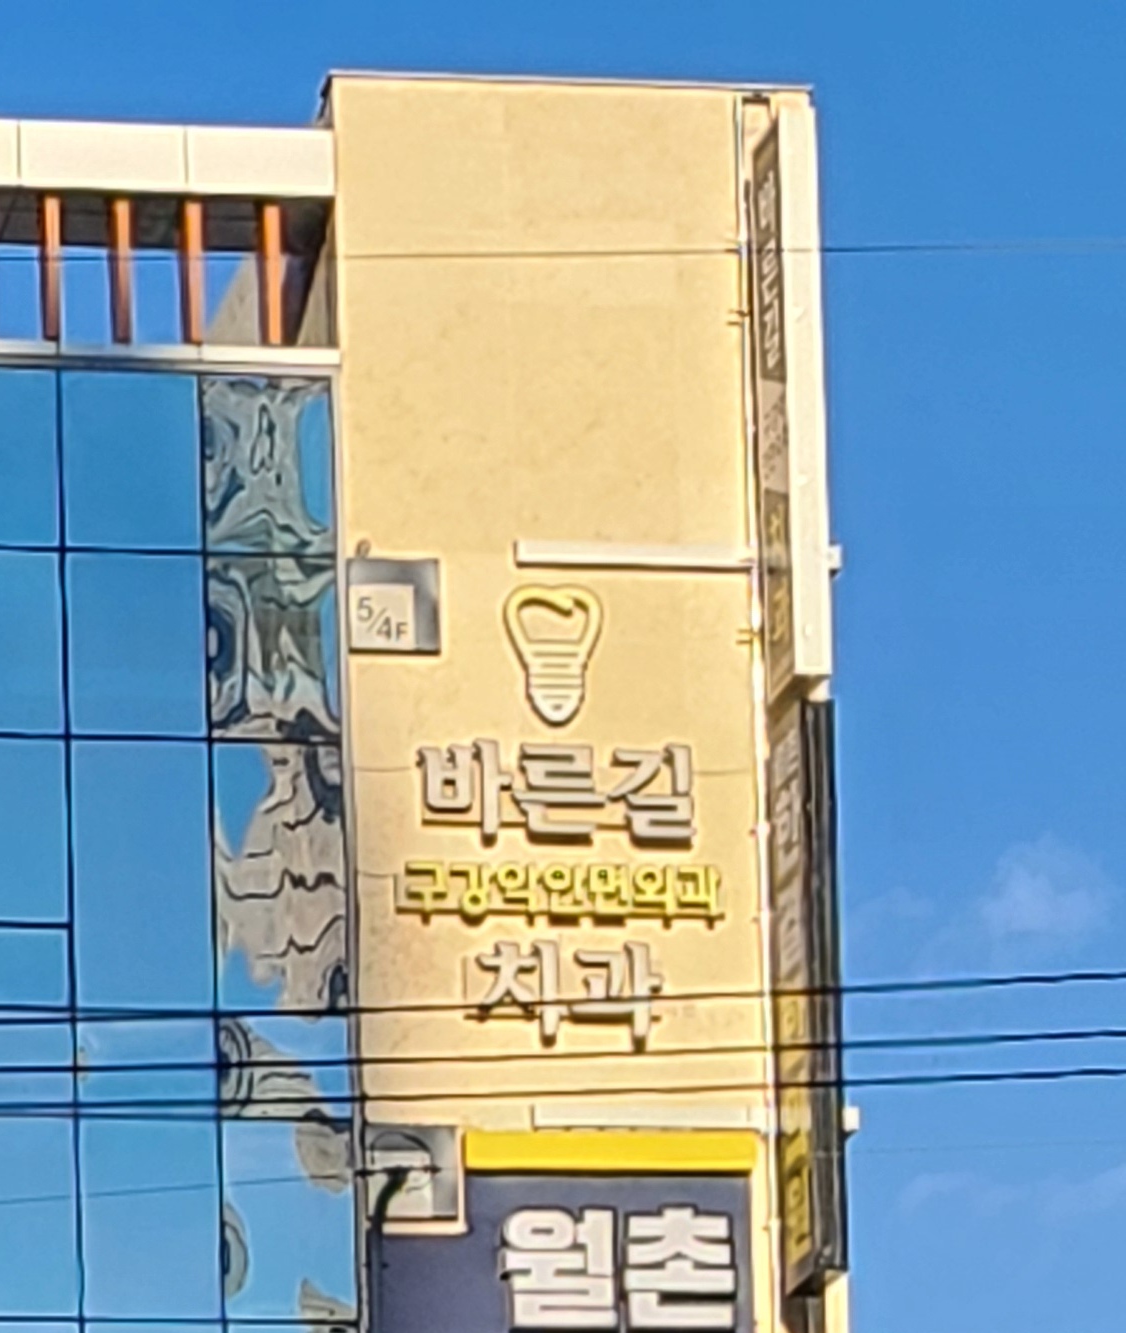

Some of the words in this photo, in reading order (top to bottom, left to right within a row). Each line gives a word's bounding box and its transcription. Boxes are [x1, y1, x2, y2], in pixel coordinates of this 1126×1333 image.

[356, 596, 408, 641] 5/4F
[417, 738, 696, 845] 바른길
[405, 860, 720, 925] 구강악안면외과
[474, 940, 664, 1049] 치과
[502, 1204, 736, 1333] 월촌
